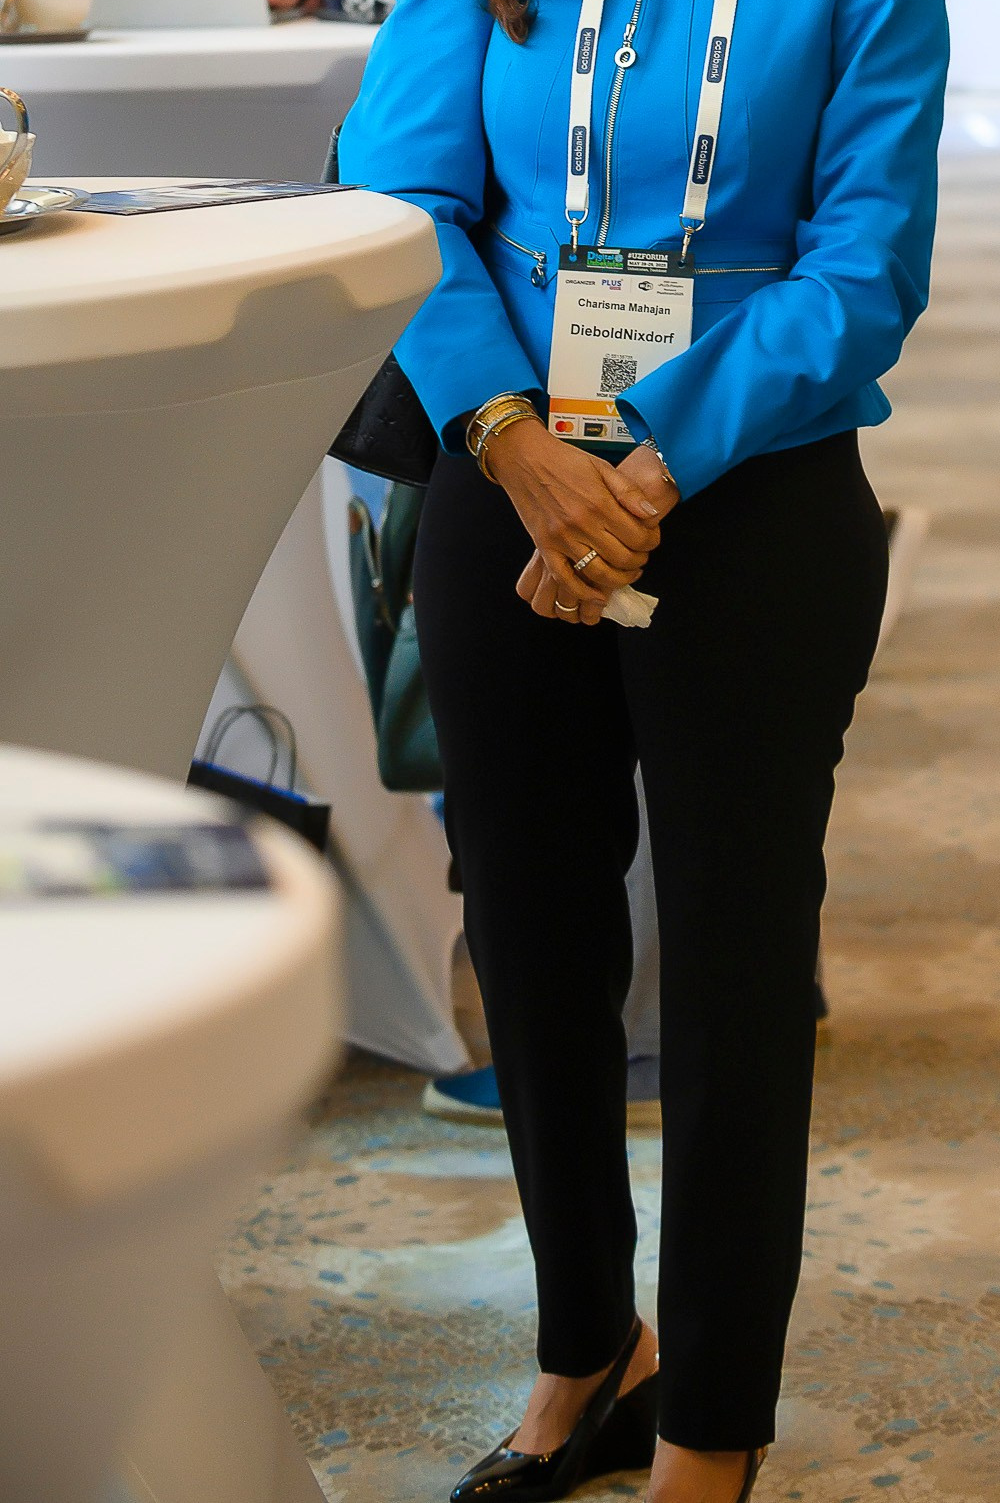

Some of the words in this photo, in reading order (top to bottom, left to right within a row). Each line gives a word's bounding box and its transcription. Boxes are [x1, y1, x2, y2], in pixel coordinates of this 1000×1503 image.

[581, 31, 592, 70] octobank
[711, 40, 722, 79] octobank
[574, 130, 584, 172] octobank
[696, 139, 708, 180] octobank
[587, 251, 615, 263] Digital
[627, 252, 668, 261] #UZFORUM
[601, 279, 621, 287] PLUS
[578, 298, 625, 311] Charisma
[628, 303, 671, 316] Mahajan
[570, 324, 675, 344] DieboldNixdorf
